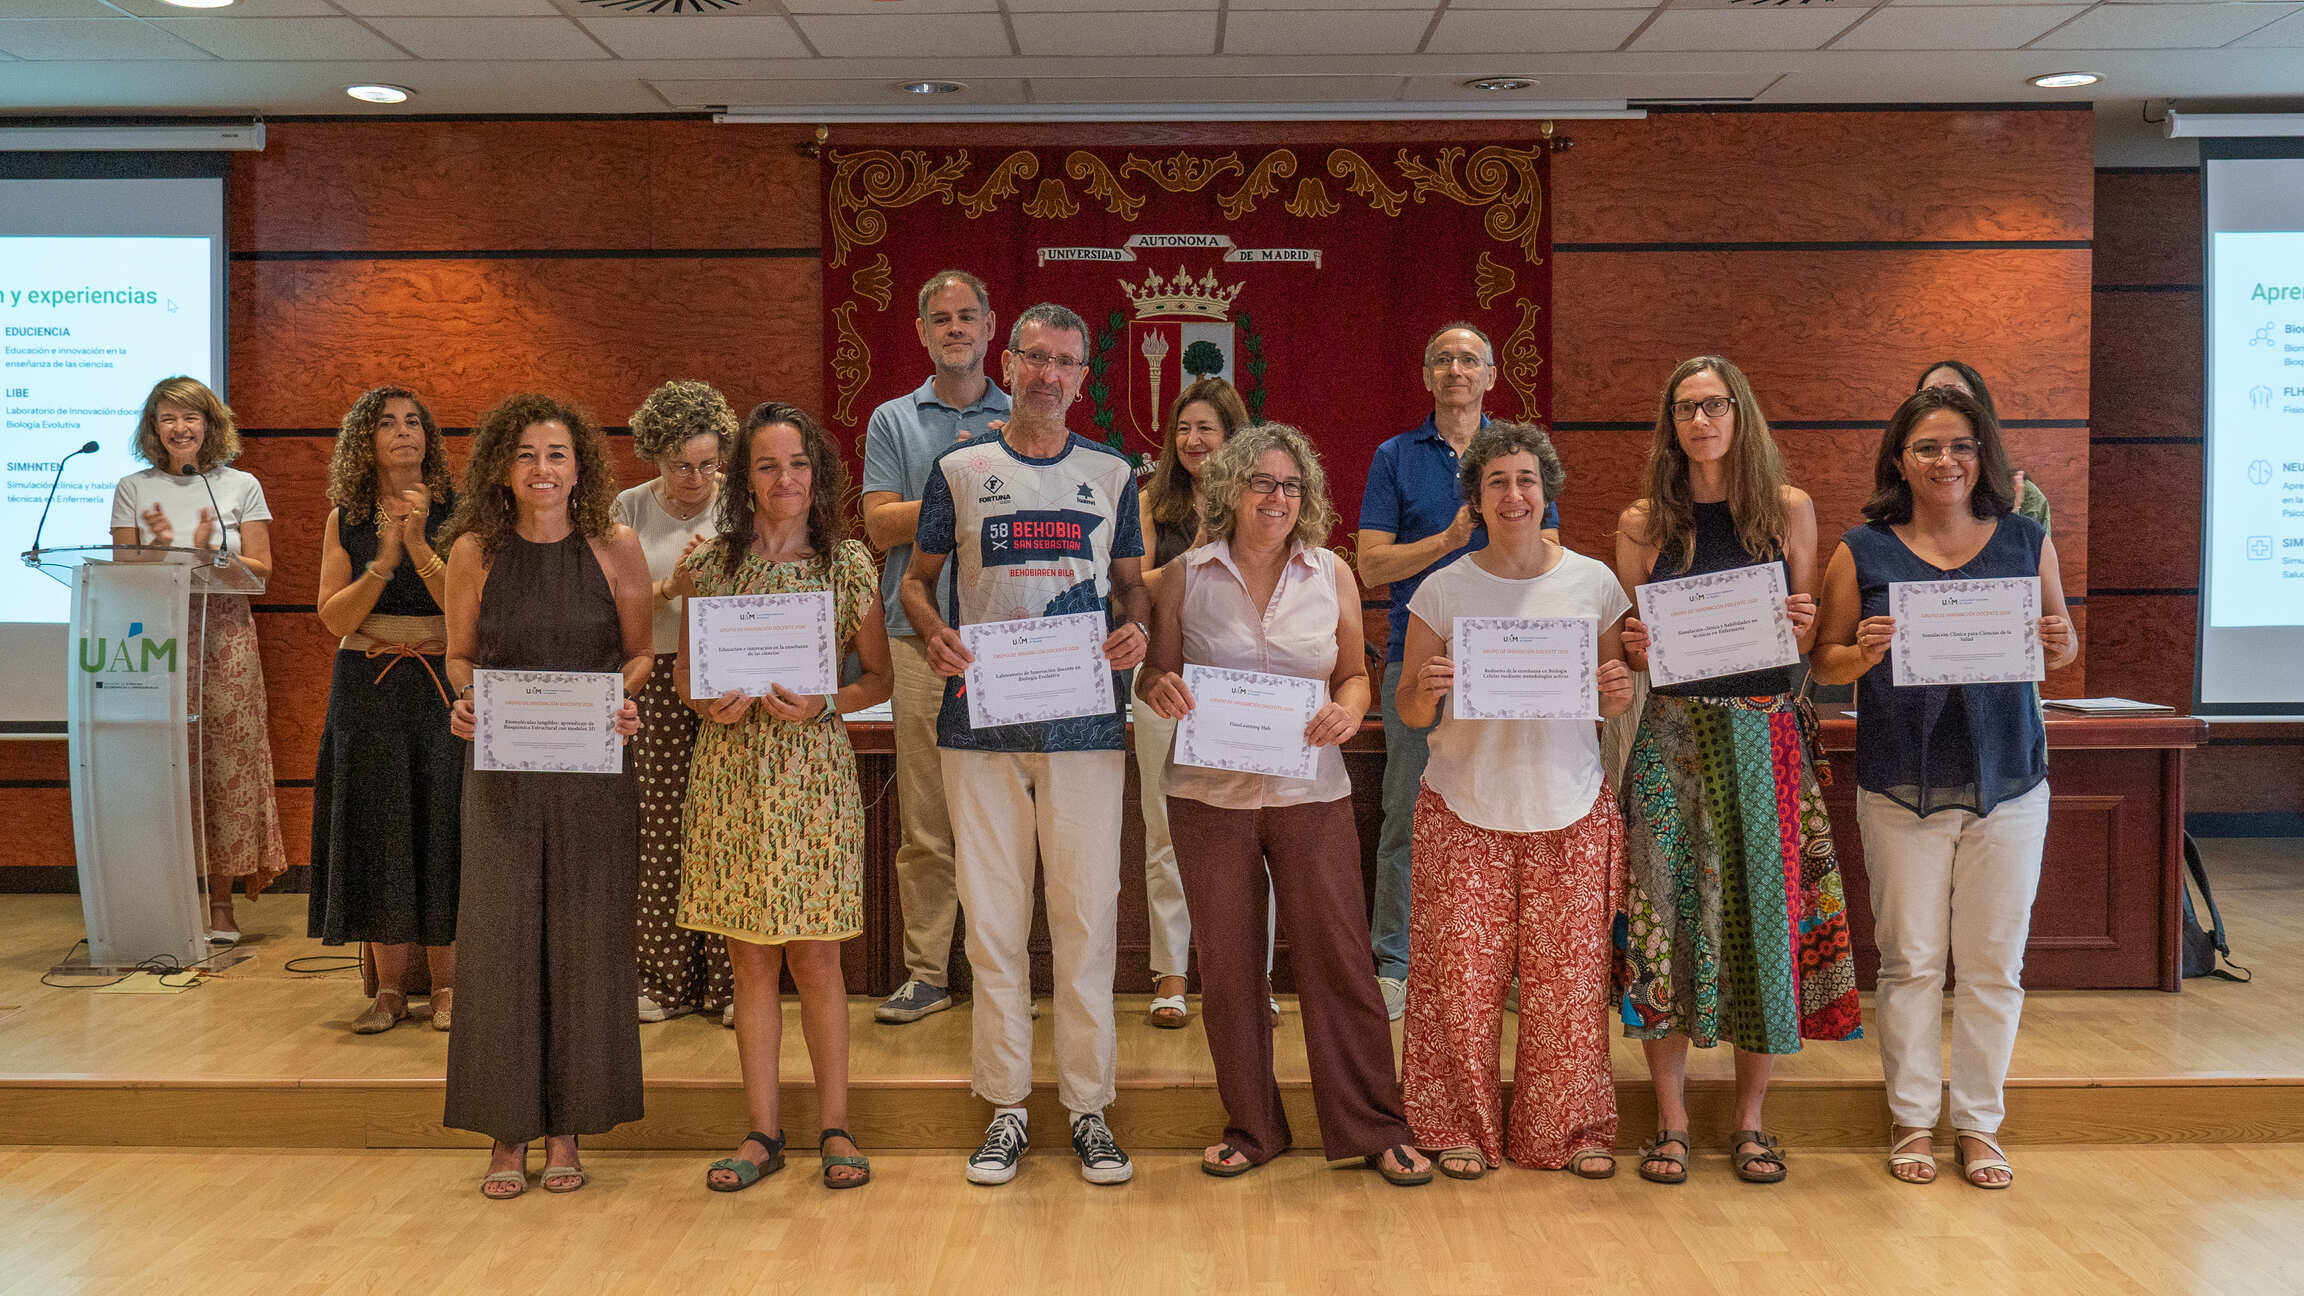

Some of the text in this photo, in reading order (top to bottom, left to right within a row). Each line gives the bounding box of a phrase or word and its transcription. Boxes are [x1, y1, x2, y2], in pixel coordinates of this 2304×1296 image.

[1048, 236, 1309, 261] UNIVERSIDAD AUTONOMA DE MADRID
[10, 290, 22, 308] y
[28, 286, 158, 308] experiencias
[2251, 282, 2304, 304] Apre
[5, 327, 71, 337] EDUCIENCIA
[5, 345, 50, 355] Educación
[58, 345, 105, 355] innovación
[106, 347, 118, 355] en
[119, 346, 127, 355] la
[5, 359, 114, 369] enseñanza de las ciencias
[6, 388, 30, 398] LIBE
[6, 406, 56, 416] Laboratorio
[57, 407, 68, 416] de
[69, 407, 117, 416] Innovación
[6, 420, 81, 431] Biología Evolutiva
[979, 494, 1012, 503] FORTUNA
[990, 521, 1081, 540] 58 BEHOBIA
[1014, 540, 1081, 551] SAN SEBASTIAN
[1009, 568, 1075, 577] BEHOBIAREN BILA
[79, 637, 177, 673] UAM
